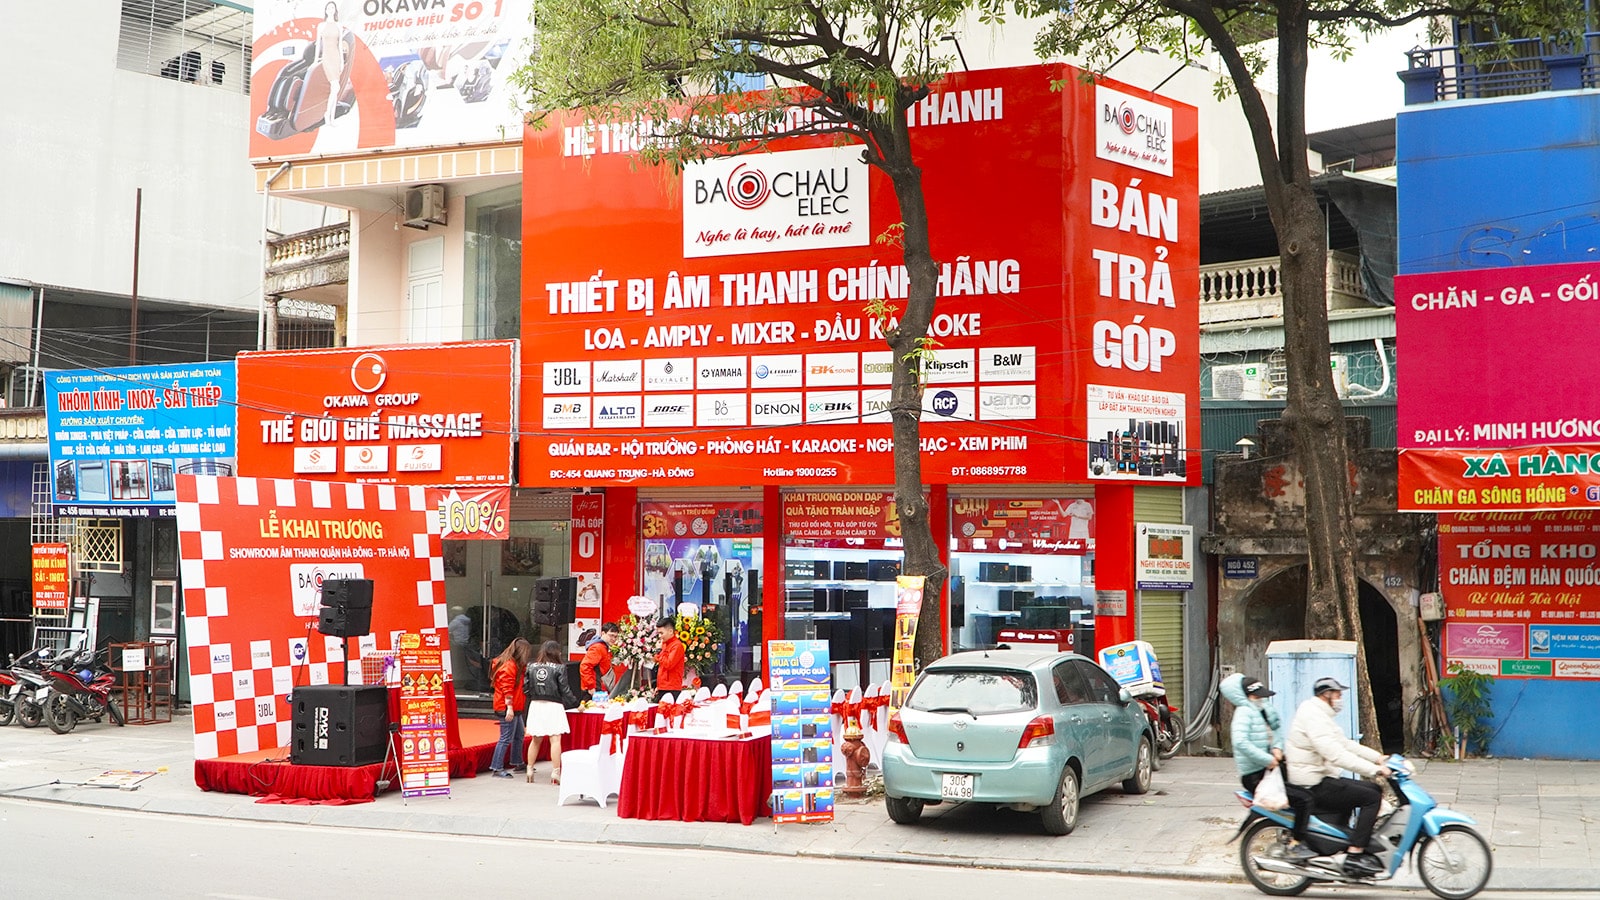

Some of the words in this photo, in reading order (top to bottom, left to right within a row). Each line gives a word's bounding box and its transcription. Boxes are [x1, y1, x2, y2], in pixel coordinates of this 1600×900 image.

[363, 18, 413, 32] THƯƠNG
[416, 14, 444, 27] HIỆU
[1136, 114, 1167, 138] CHAU
[1146, 135, 1167, 152] ELEC
[772, 167, 849, 198] CHAU
[798, 195, 850, 217] ELEC
[1091, 177, 1178, 243] BÁN
[695, 230, 732, 247] Nghe
[734, 228, 747, 241] là
[750, 227, 781, 244] hay,
[784, 224, 808, 237] hát
[811, 222, 825, 236] là
[828, 221, 853, 234] mê
[1092, 245, 1176, 309] TRẢ
[545, 270, 619, 315] THIẾT
[626, 278, 655, 317] BỊ
[662, 271, 711, 310] ÂM
[720, 269, 819, 307] THANH
[1411, 286, 1478, 311] CHĂN
[1500, 286, 1535, 306] GA
[1557, 273, 1599, 302] GỐI
[584, 327, 626, 351] LOA
[644, 324, 713, 349] AMPLY
[731, 321, 795, 345] MIXER
[814, 312, 860, 342] ĐẦU
[1092, 314, 1176, 373] GÓP
[925, 358, 969, 372] Klipsch
[993, 353, 1022, 367] B&W
[556, 368, 582, 386] JBL
[596, 370, 639, 384] Marshall
[648, 376, 690, 384] DEVIALET
[710, 367, 743, 378] YAMAHA
[58, 387, 91, 412] NHÔM
[163, 381, 187, 408] SẮT
[189, 382, 222, 407] THÉP
[323, 395, 369, 408] OKAWA
[374, 392, 420, 406] GROUP
[934, 396, 957, 410] RCF
[982, 394, 1032, 407] Jamo
[553, 403, 582, 414] BMB
[599, 405, 637, 416] ALTO
[653, 405, 688, 414] BOSE
[755, 402, 800, 415] DENON
[260, 411, 295, 444] THẾ
[300, 411, 338, 443] GIỚI
[343, 409, 383, 441] GHẾ
[387, 412, 483, 439] MASSAGE
[1414, 429, 1441, 445] ĐẠI
[1445, 425, 1470, 442] LÝ:
[1473, 422, 1527, 441] MINH
[548, 438, 586, 457] QUÁN
[586, 442, 611, 457] BAR
[621, 438, 644, 458] HỘI
[645, 437, 698, 456] TRƯỜNG
[707, 436, 755, 455] PHÒNG
[756, 435, 782, 454] HÁT
[791, 438, 857, 454] KARAOKE
[866, 437, 895, 452] NGH
[918, 436, 948, 456] HẠC
[959, 436, 989, 451] XEM
[991, 435, 1028, 450] PHIM
[404, 462, 433, 470] FUJISU
[763, 467, 793, 477] Hotline
[951, 467, 969, 476] ĐT:
[970, 465, 1028, 476] 0868957788
[1413, 486, 1454, 505] CHĂN
[1457, 488, 1478, 505] GA
[1481, 485, 1522, 504] SÔNG
[1525, 482, 1567, 503] HỒNG
[785, 505, 804, 516] QUÀ
[805, 505, 829, 518] TẶNG
[830, 504, 855, 516] TRÀN
[855, 504, 881, 517] NGẬP
[259, 509, 280, 539] LỄ
[282, 520, 321, 539] KHAI
[322, 520, 384, 540] TRƯƠNG
[450, 506, 505, 538] 60%
[229, 547, 279, 559] SHOWROOM
[280, 546, 293, 558] ÂM
[294, 547, 320, 558] THANH
[320, 545, 341, 560] QUẬN
[341, 546, 352, 558] HÀ
[352, 546, 374, 558] ĐÔNG
[387, 546, 398, 558] HÀ
[398, 546, 410, 560] NỘI
[1242, 560, 1255, 569] 452
[1385, 577, 1402, 587] 452
[1449, 564, 1490, 586] CHĂN
[1493, 564, 1527, 589] ĐỆM
[1530, 564, 1561, 586] HÀN
[217, 710, 235, 719] Klipsch
[258, 702, 274, 718] JBL
[320, 707, 329, 738] DMX
[949, 775, 966, 787] 30G
